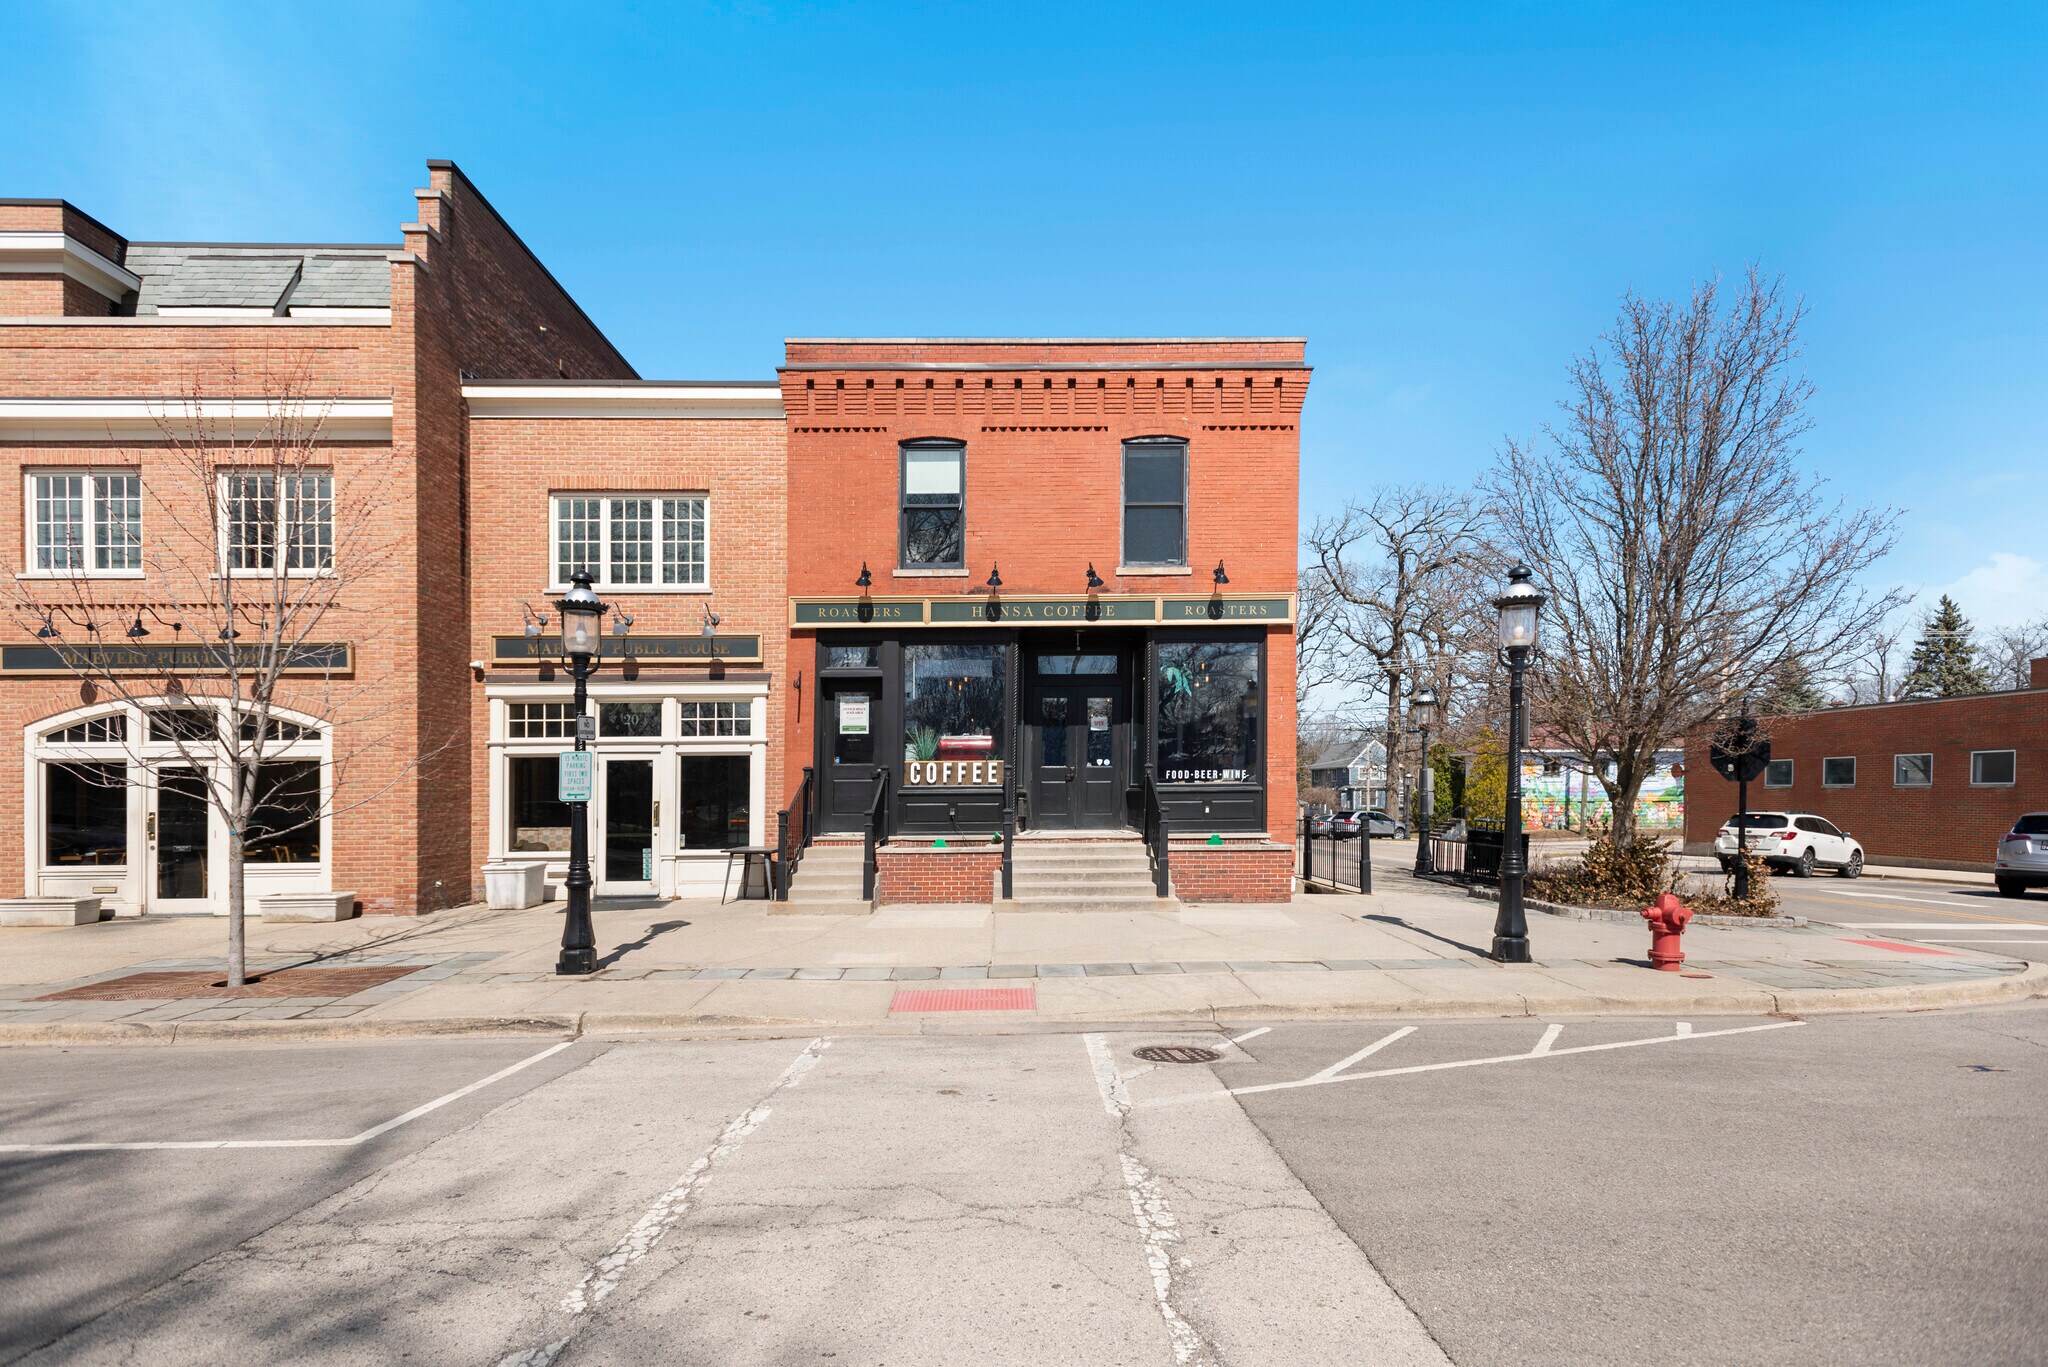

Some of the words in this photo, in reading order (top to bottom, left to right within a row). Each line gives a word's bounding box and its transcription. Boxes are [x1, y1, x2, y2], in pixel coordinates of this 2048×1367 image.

[818, 607, 901, 618] ROASTERS
[971, 605, 1034, 618] HANSA
[1043, 605, 1115, 618] COFFEE
[1184, 605, 1267, 616] ROASTERS
[611, 643, 670, 655] PUBLIC
[677, 643, 729, 654] HOUSE
[63, 651, 150, 665] MAEVERY
[624, 713, 639, 725] 20
[910, 762, 998, 783] COFFEE
[1165, 770, 1190, 779] FOOD
[1194, 769, 1218, 779] BEER
